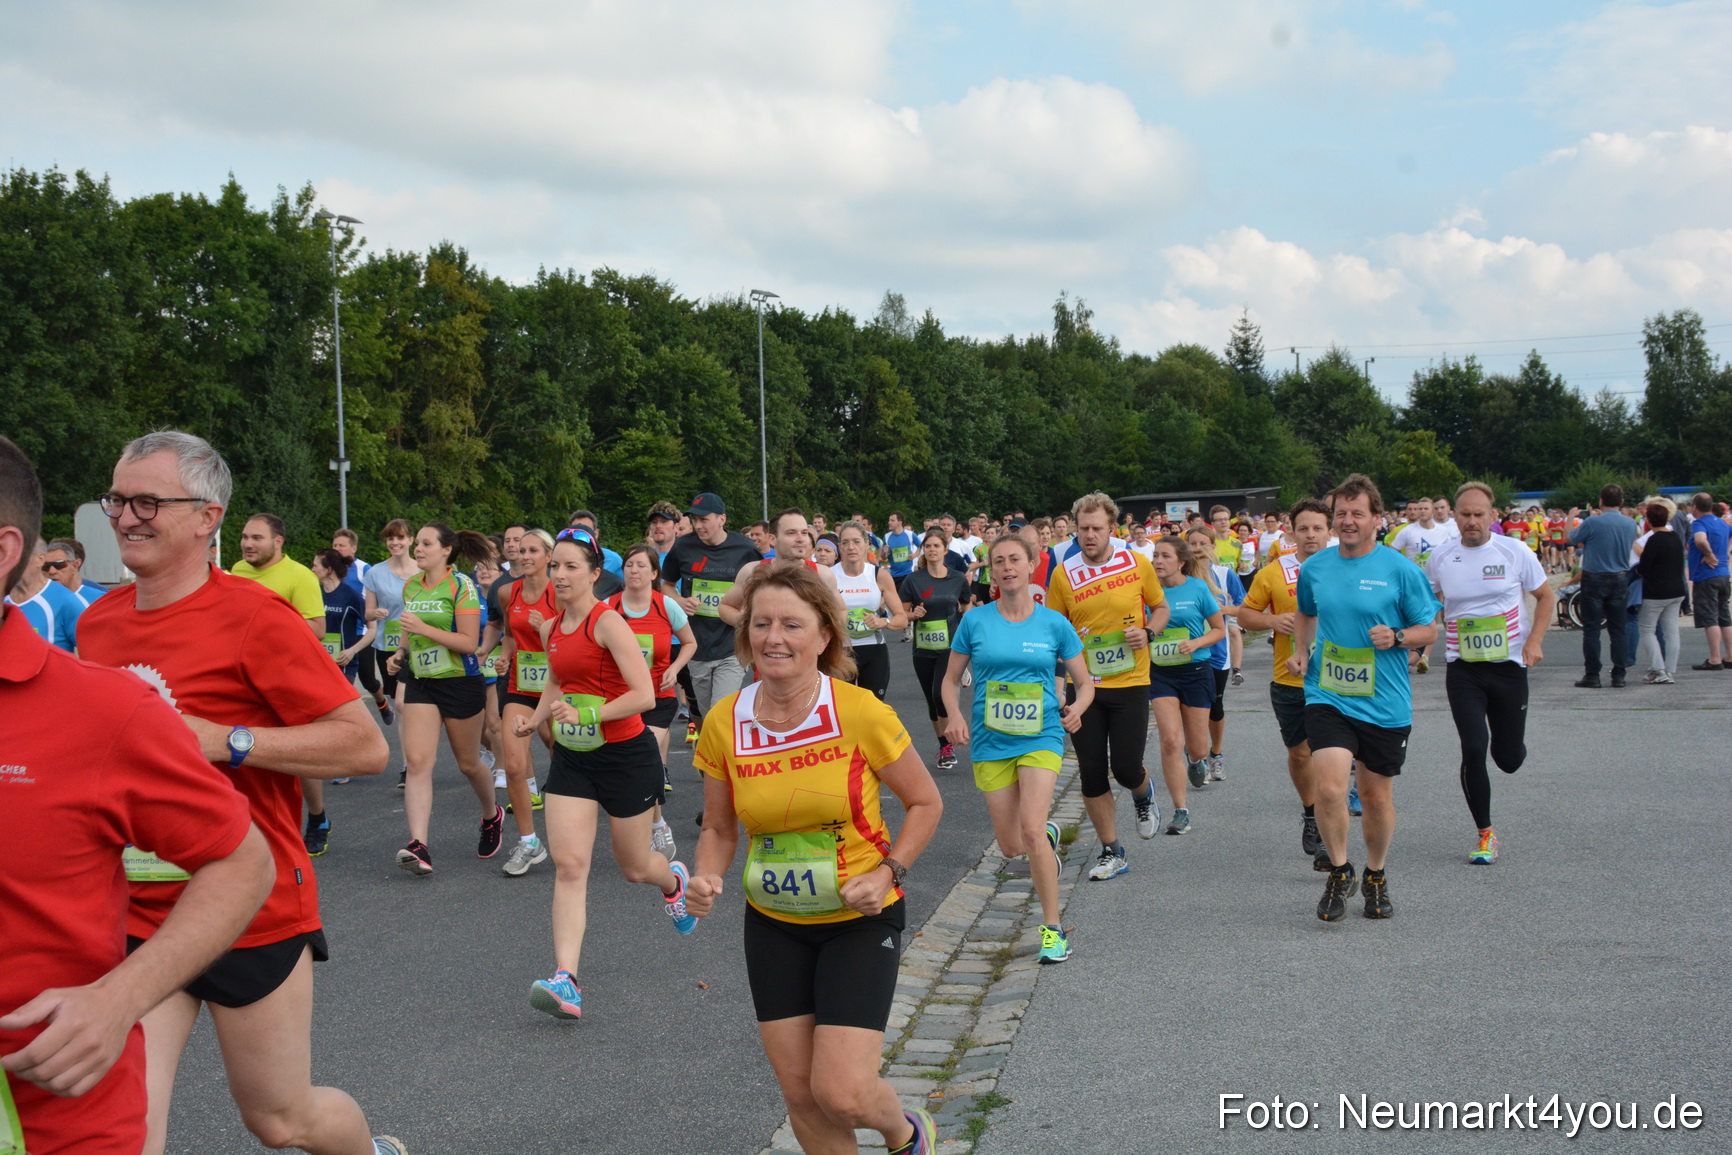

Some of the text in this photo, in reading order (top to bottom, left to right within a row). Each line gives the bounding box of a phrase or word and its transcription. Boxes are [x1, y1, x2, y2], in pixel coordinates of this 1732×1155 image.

[1074, 573, 1140, 604] MAX BÖGL
[697, 593, 723, 607] 149
[919, 632, 946, 643] 1488
[1463, 633, 1503, 650] 1000
[417, 649, 439, 667] 127
[1095, 647, 1126, 665] 924
[1154, 643, 1184, 657] 107
[1326, 662, 1369, 683] 1064
[992, 702, 1038, 721] 1092
[735, 745, 849, 779] MAX BÖGL
[761, 869, 817, 897] 841
